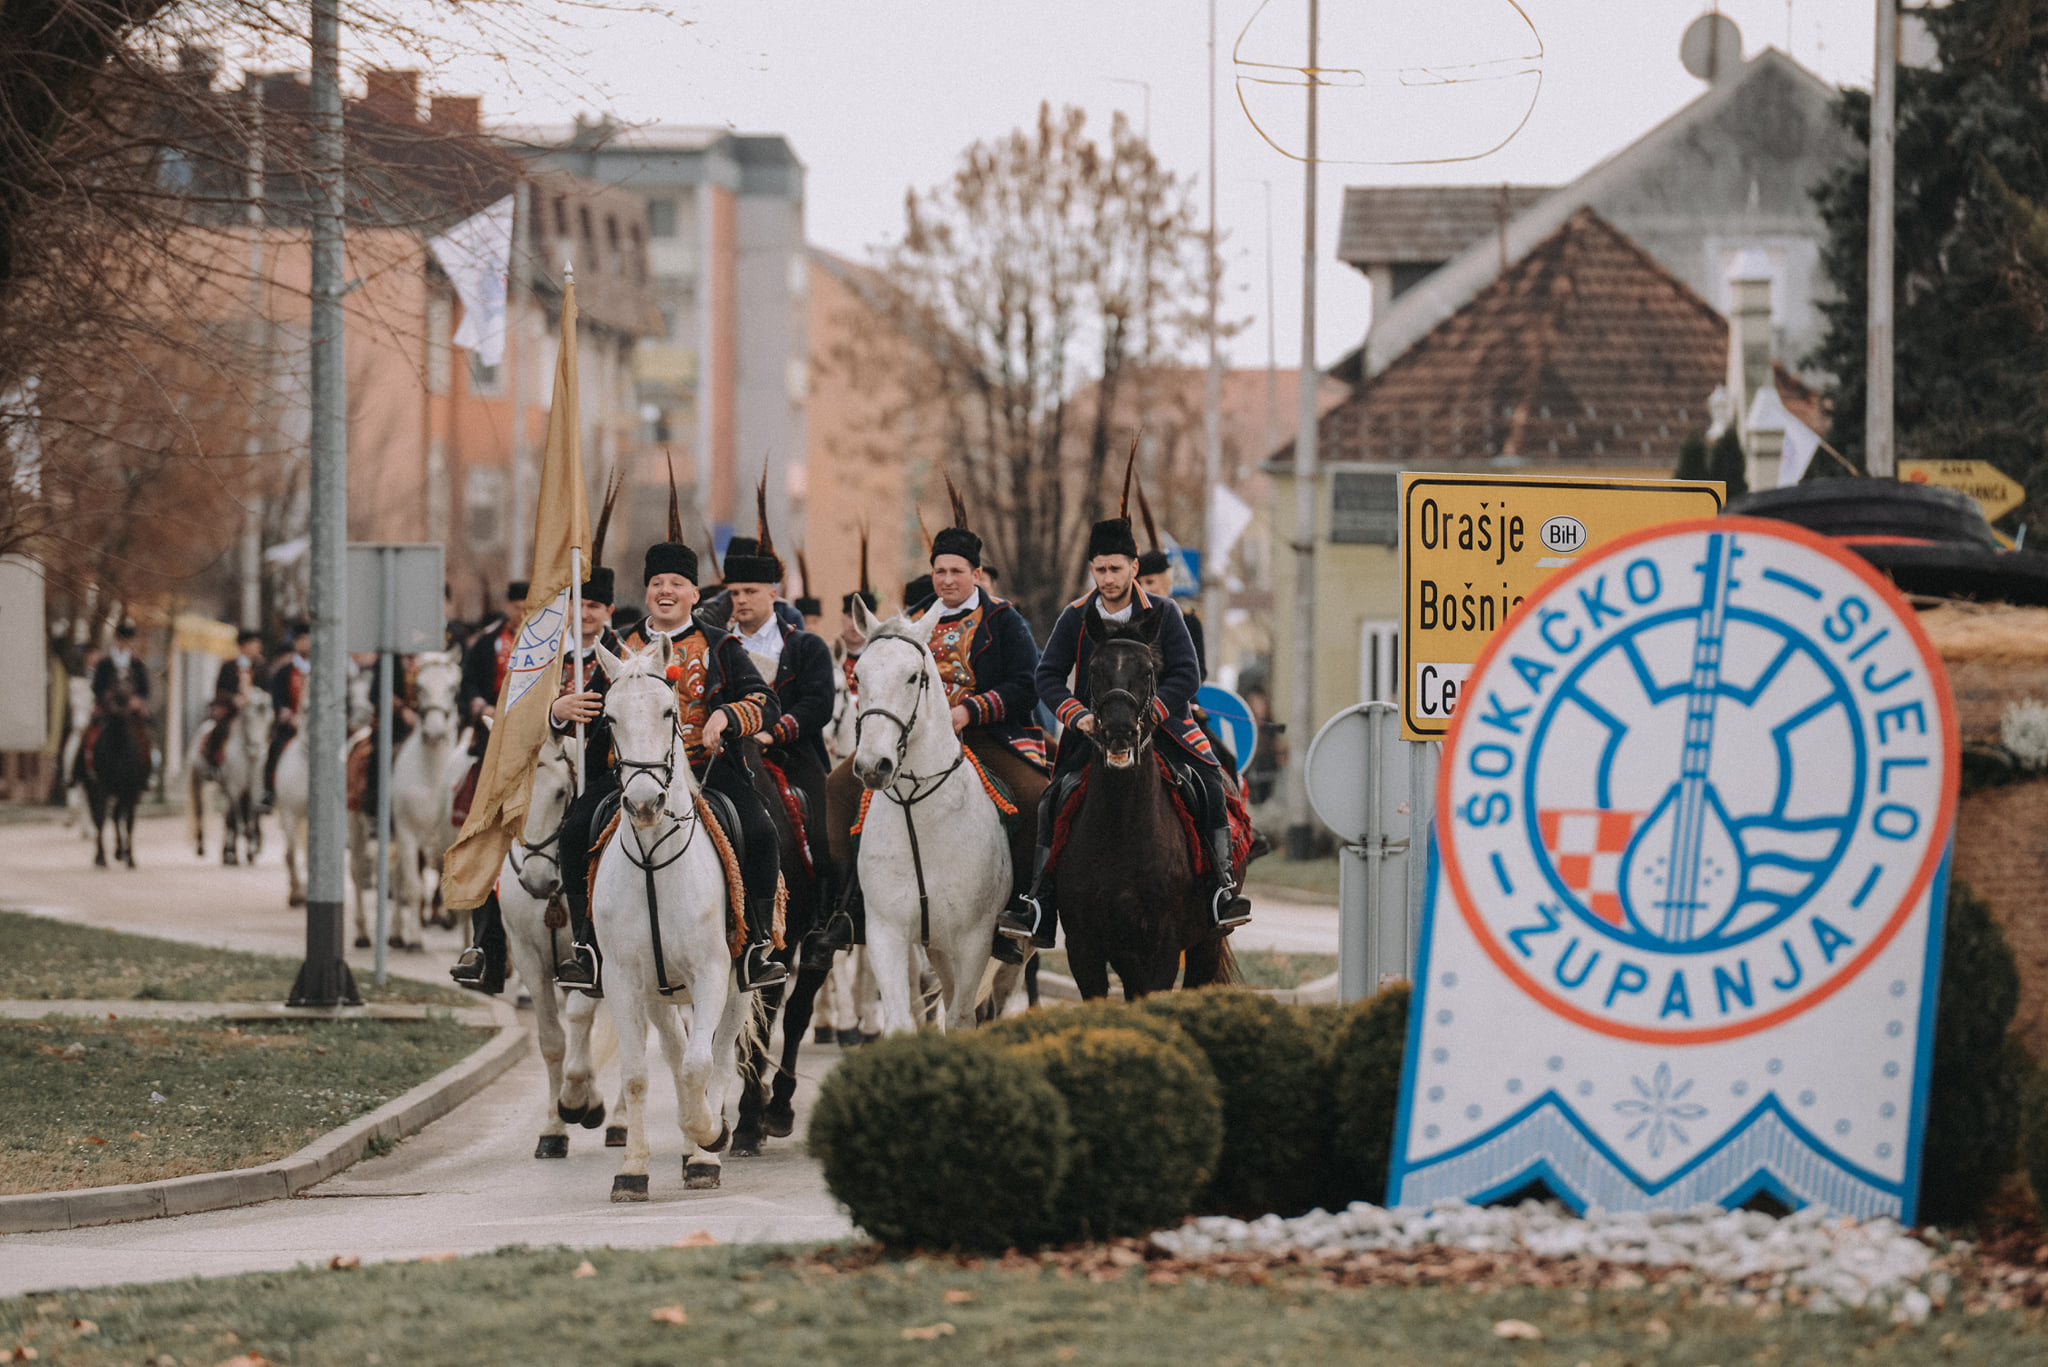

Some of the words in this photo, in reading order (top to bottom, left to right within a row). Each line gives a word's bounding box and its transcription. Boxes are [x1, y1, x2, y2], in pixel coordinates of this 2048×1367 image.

[1421, 498, 1524, 565] Orašje
[1550, 525, 1577, 544] BiH
[1421, 665, 1469, 715] Ce
[1456, 557, 1662, 827] ŠOKAČKO
[1822, 595, 1928, 841] SIJELO
[1507, 903, 1854, 1019] ŽUPANJA
